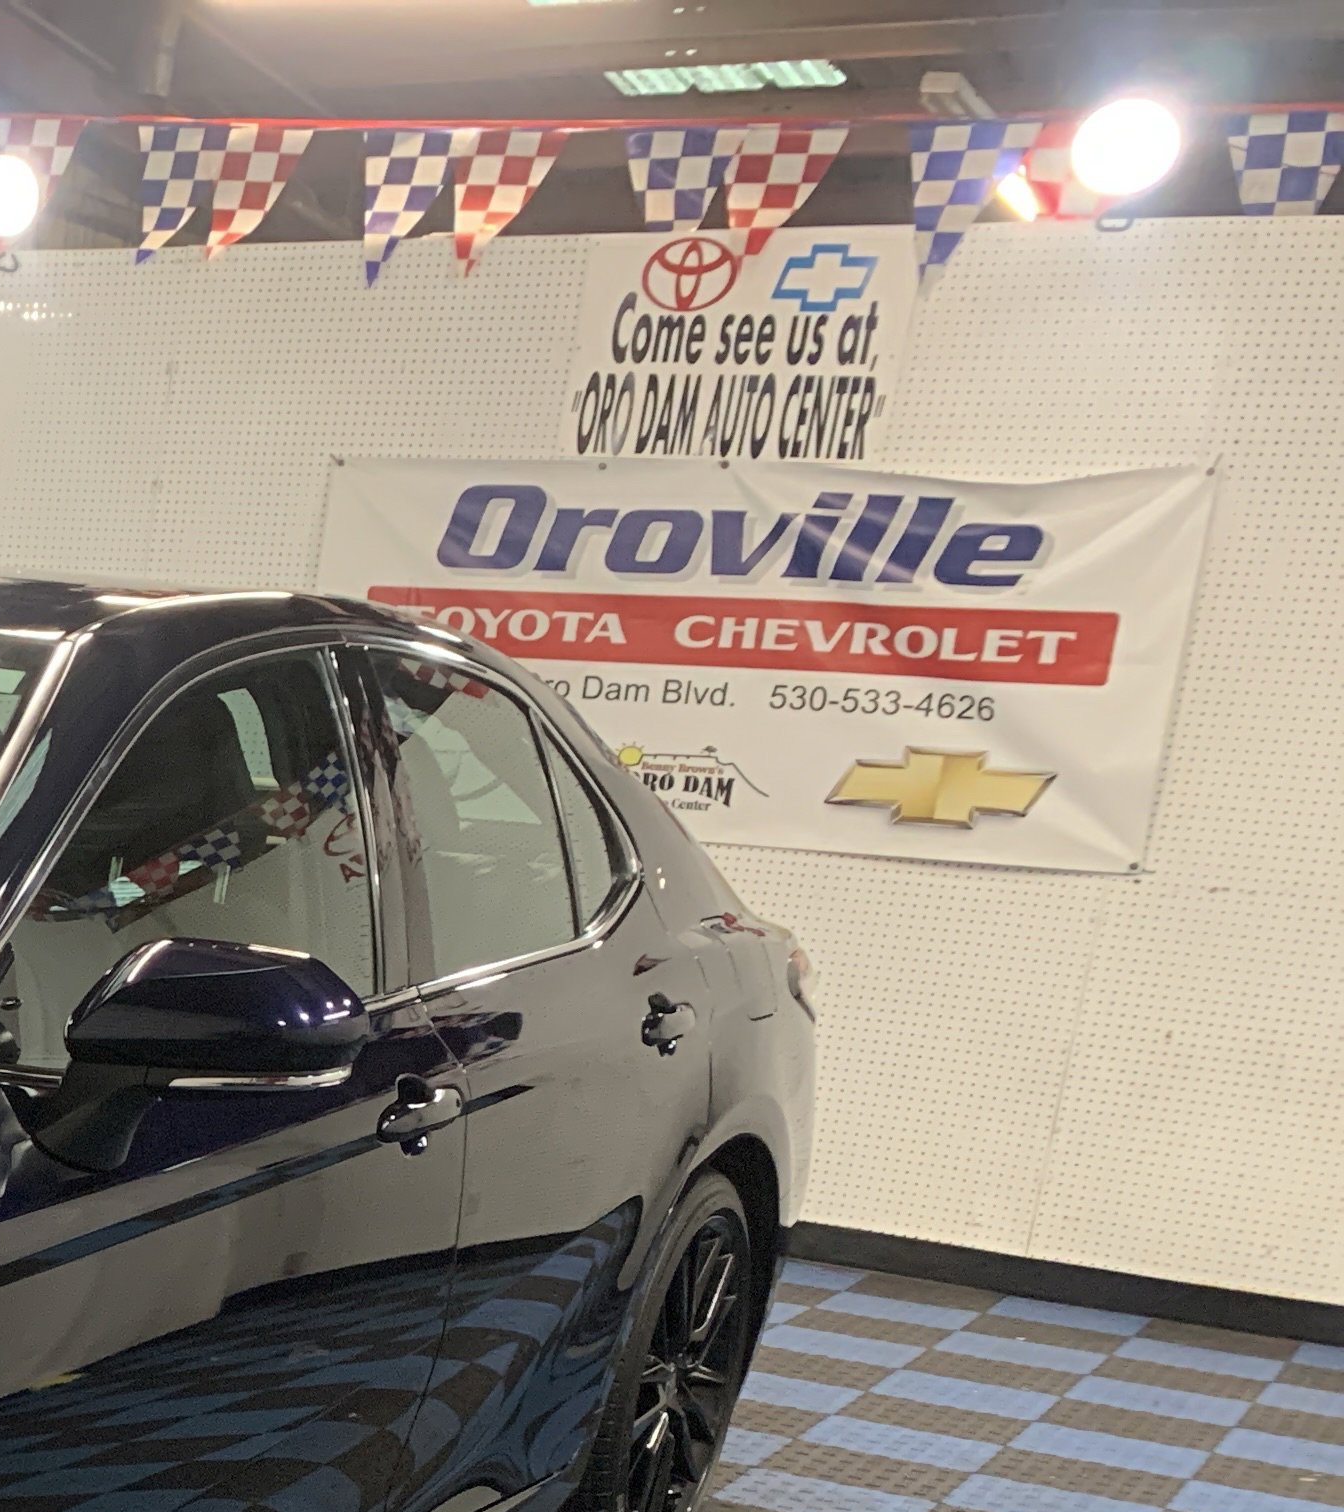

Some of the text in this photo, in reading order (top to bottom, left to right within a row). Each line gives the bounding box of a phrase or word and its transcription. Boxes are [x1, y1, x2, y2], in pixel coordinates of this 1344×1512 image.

[611, 291, 879, 372] Come see us at,
[571, 371, 887, 460] "ORO DAM AUTO CENTER"
[436, 484, 1047, 590] Oroville
[674, 614, 1078, 666] CHEVROLET
[582, 675, 650, 704] Dam
[662, 679, 737, 708] Blvd.
[768, 683, 997, 723] 530-533-4626
[634, 771, 736, 807] RO DAM
[641, 761, 676, 774] Benny
[671, 798, 711, 811] Center
